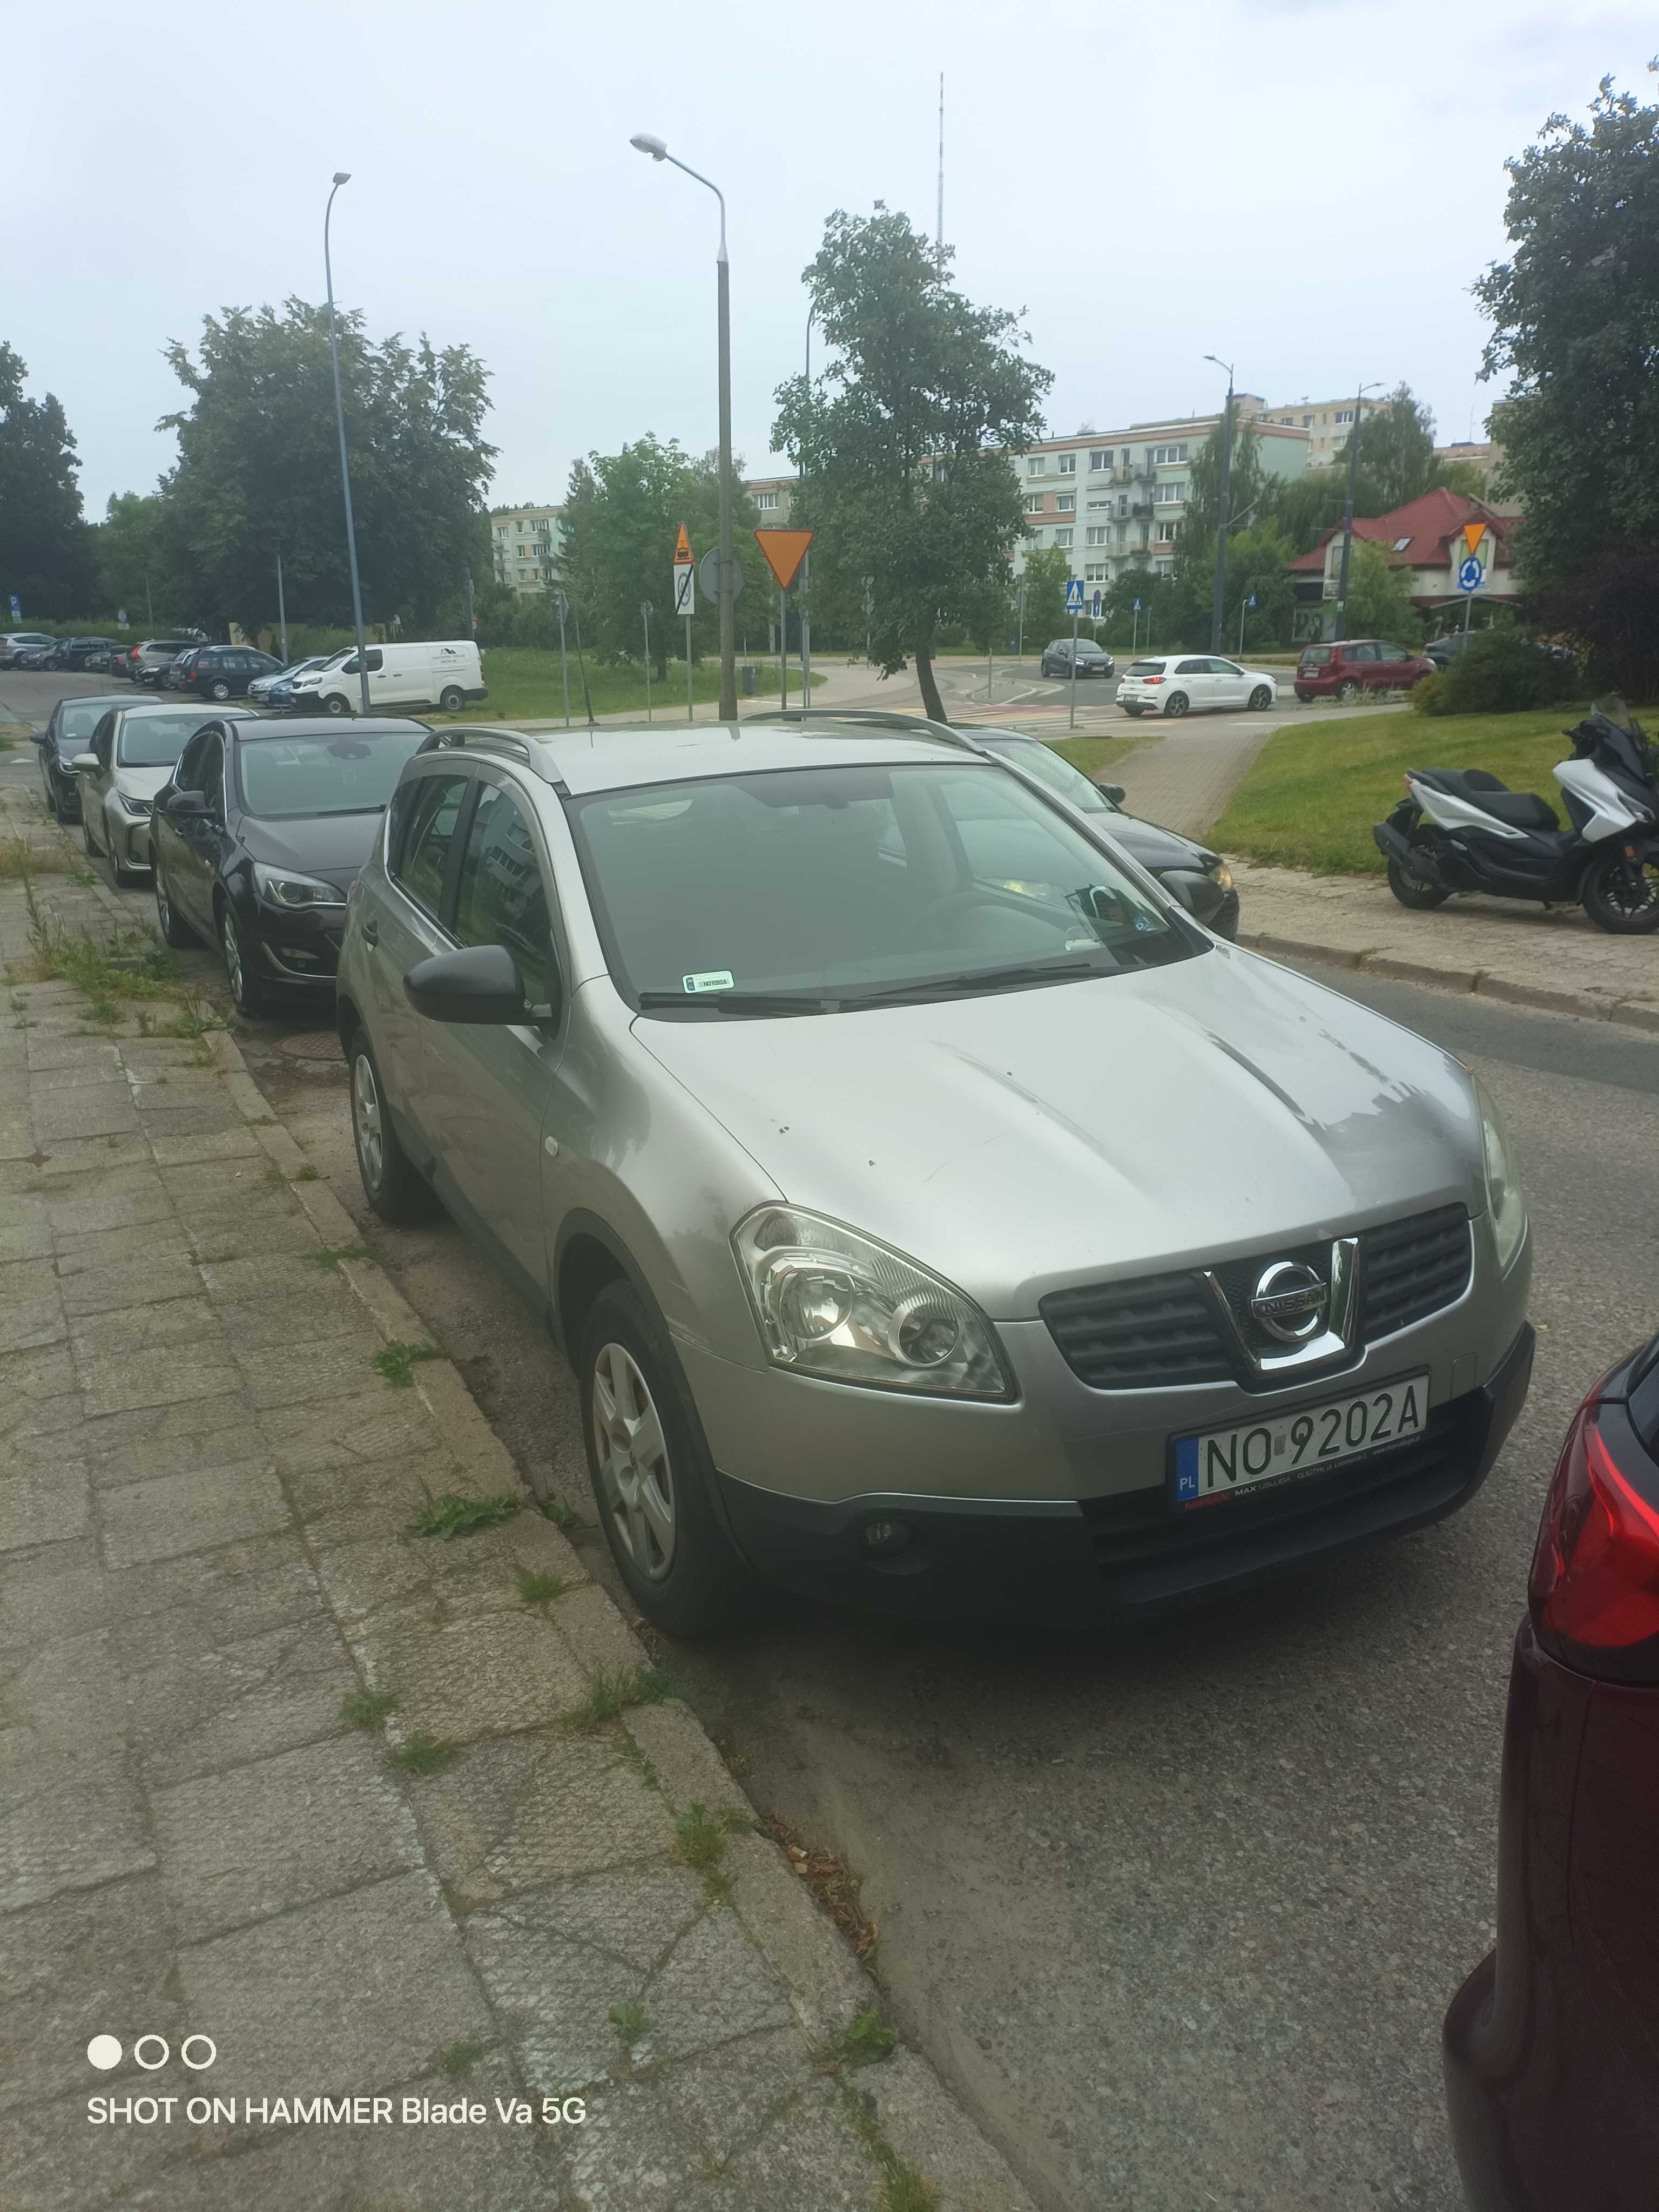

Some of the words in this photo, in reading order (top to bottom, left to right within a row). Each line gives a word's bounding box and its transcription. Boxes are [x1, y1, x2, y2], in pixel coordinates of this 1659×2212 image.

[11, 596, 17, 606] P
[1262, 1289, 1327, 1314] NISSAN
[1207, 1427, 1271, 1488] NO
[1291, 1385, 1419, 1465] 9202A
[1179, 1475, 1196, 1491] PL
[1235, 1486, 1256, 1496] MAX
